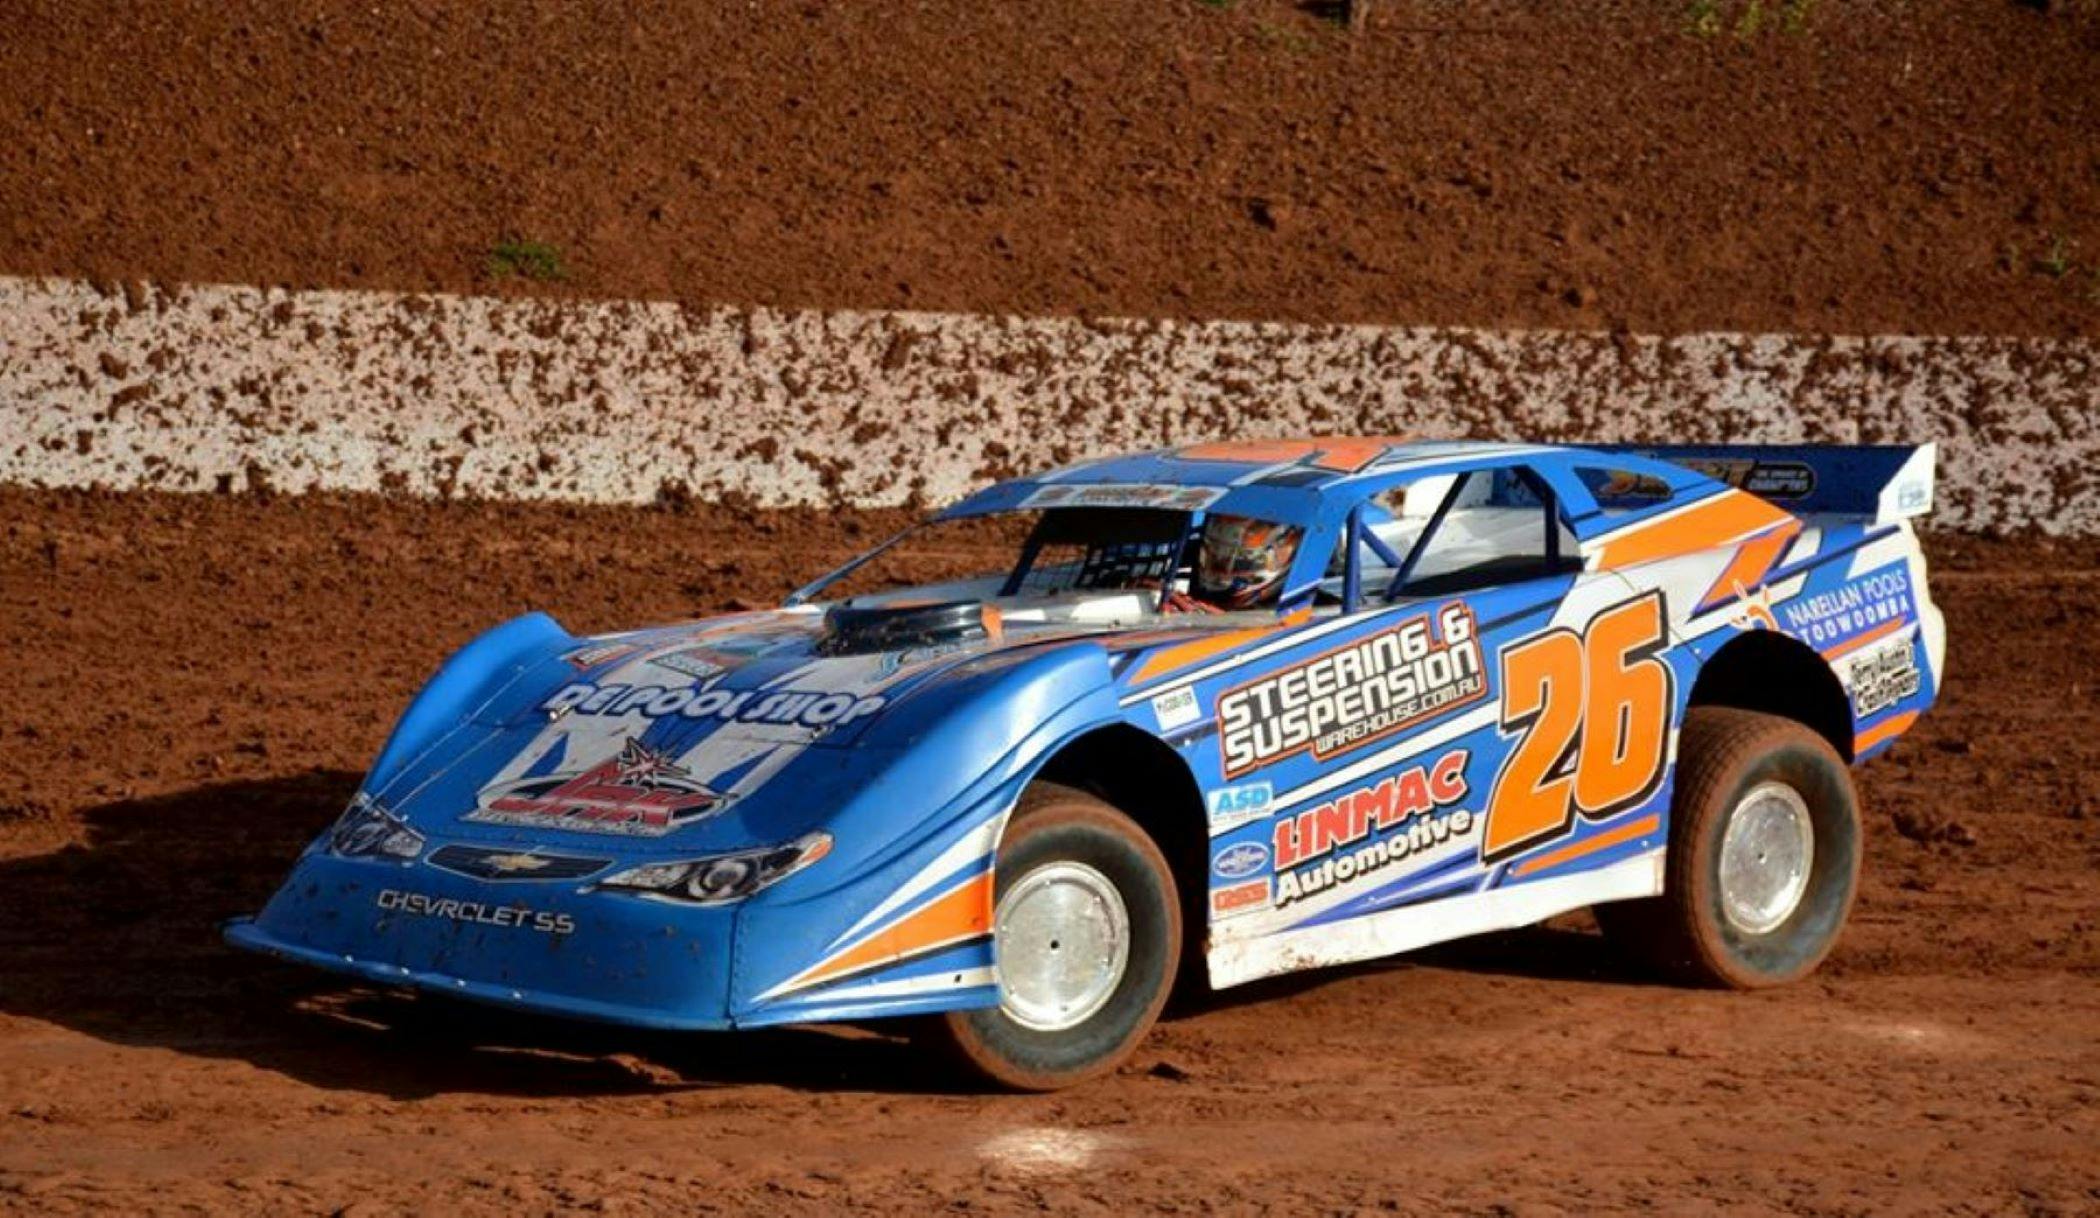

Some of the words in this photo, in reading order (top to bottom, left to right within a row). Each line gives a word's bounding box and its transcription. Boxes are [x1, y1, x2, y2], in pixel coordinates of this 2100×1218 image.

[1220, 622, 1429, 735] STEERING
[1442, 607, 1471, 645] &
[1225, 640, 1480, 771] SUSPENSION
[1482, 590, 1668, 866] 26
[1274, 750, 1468, 872] LINMAC
[1275, 809, 1472, 906] Automotive
[533, 912, 576, 934] SS
